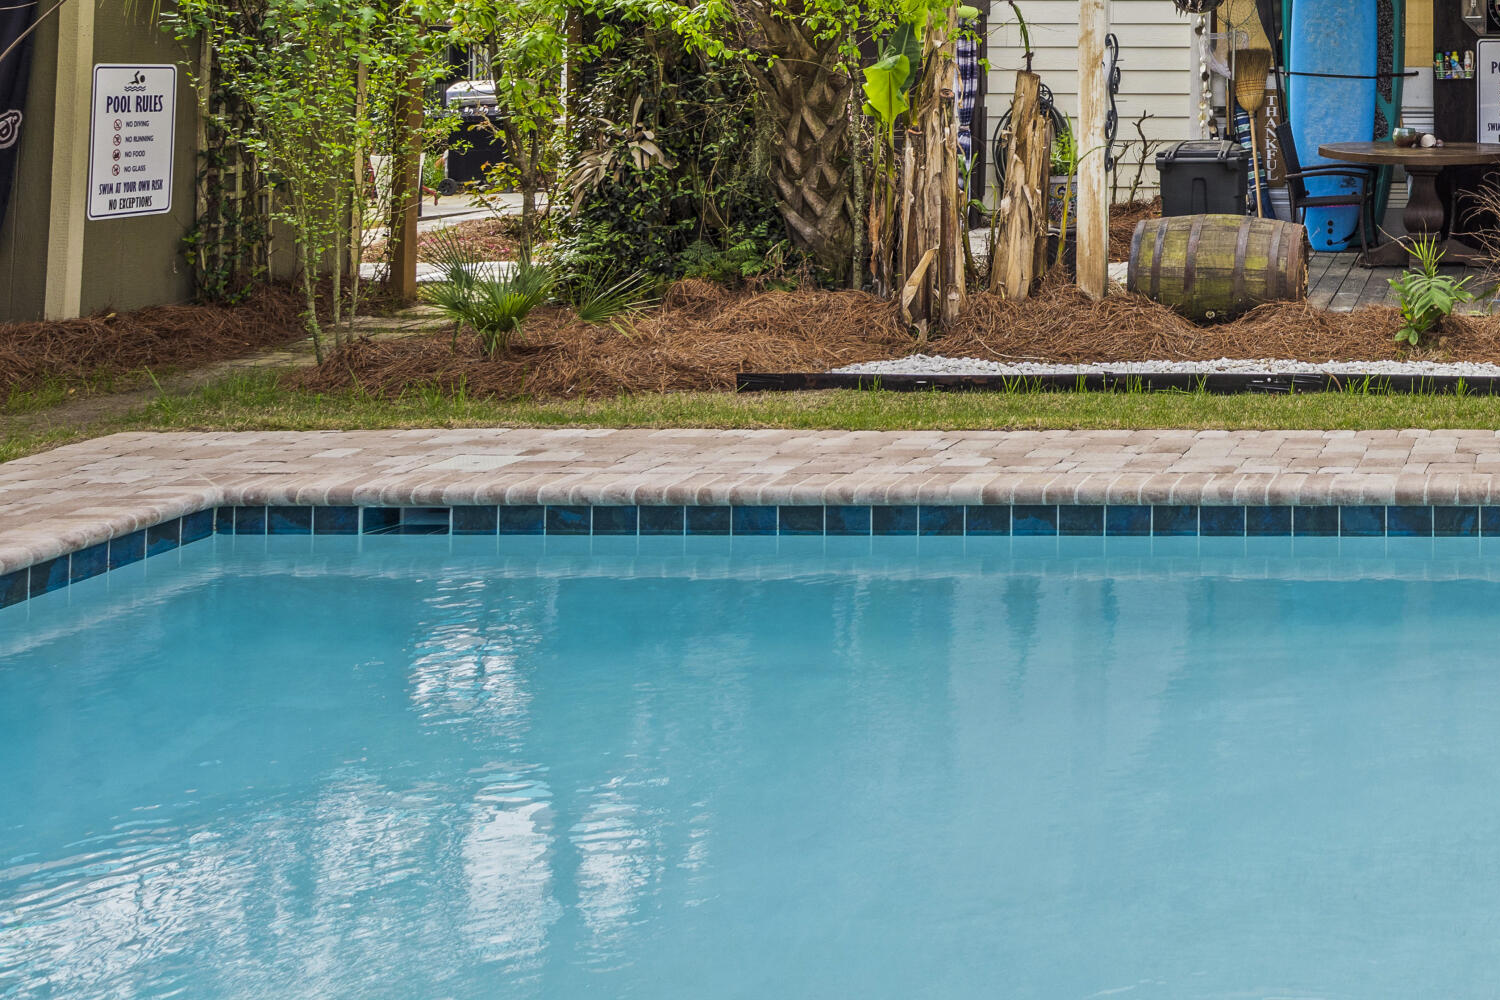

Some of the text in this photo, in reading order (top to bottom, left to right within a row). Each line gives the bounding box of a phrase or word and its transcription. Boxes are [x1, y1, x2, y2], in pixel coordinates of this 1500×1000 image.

[106, 95, 164, 113] POOL RULES
[1265, 95, 1279, 180] THANKFUL
[99, 179, 163, 195] SWIM AT YOUR OWN RISK
[108, 196, 152, 210] NO EXCEPTIONS
